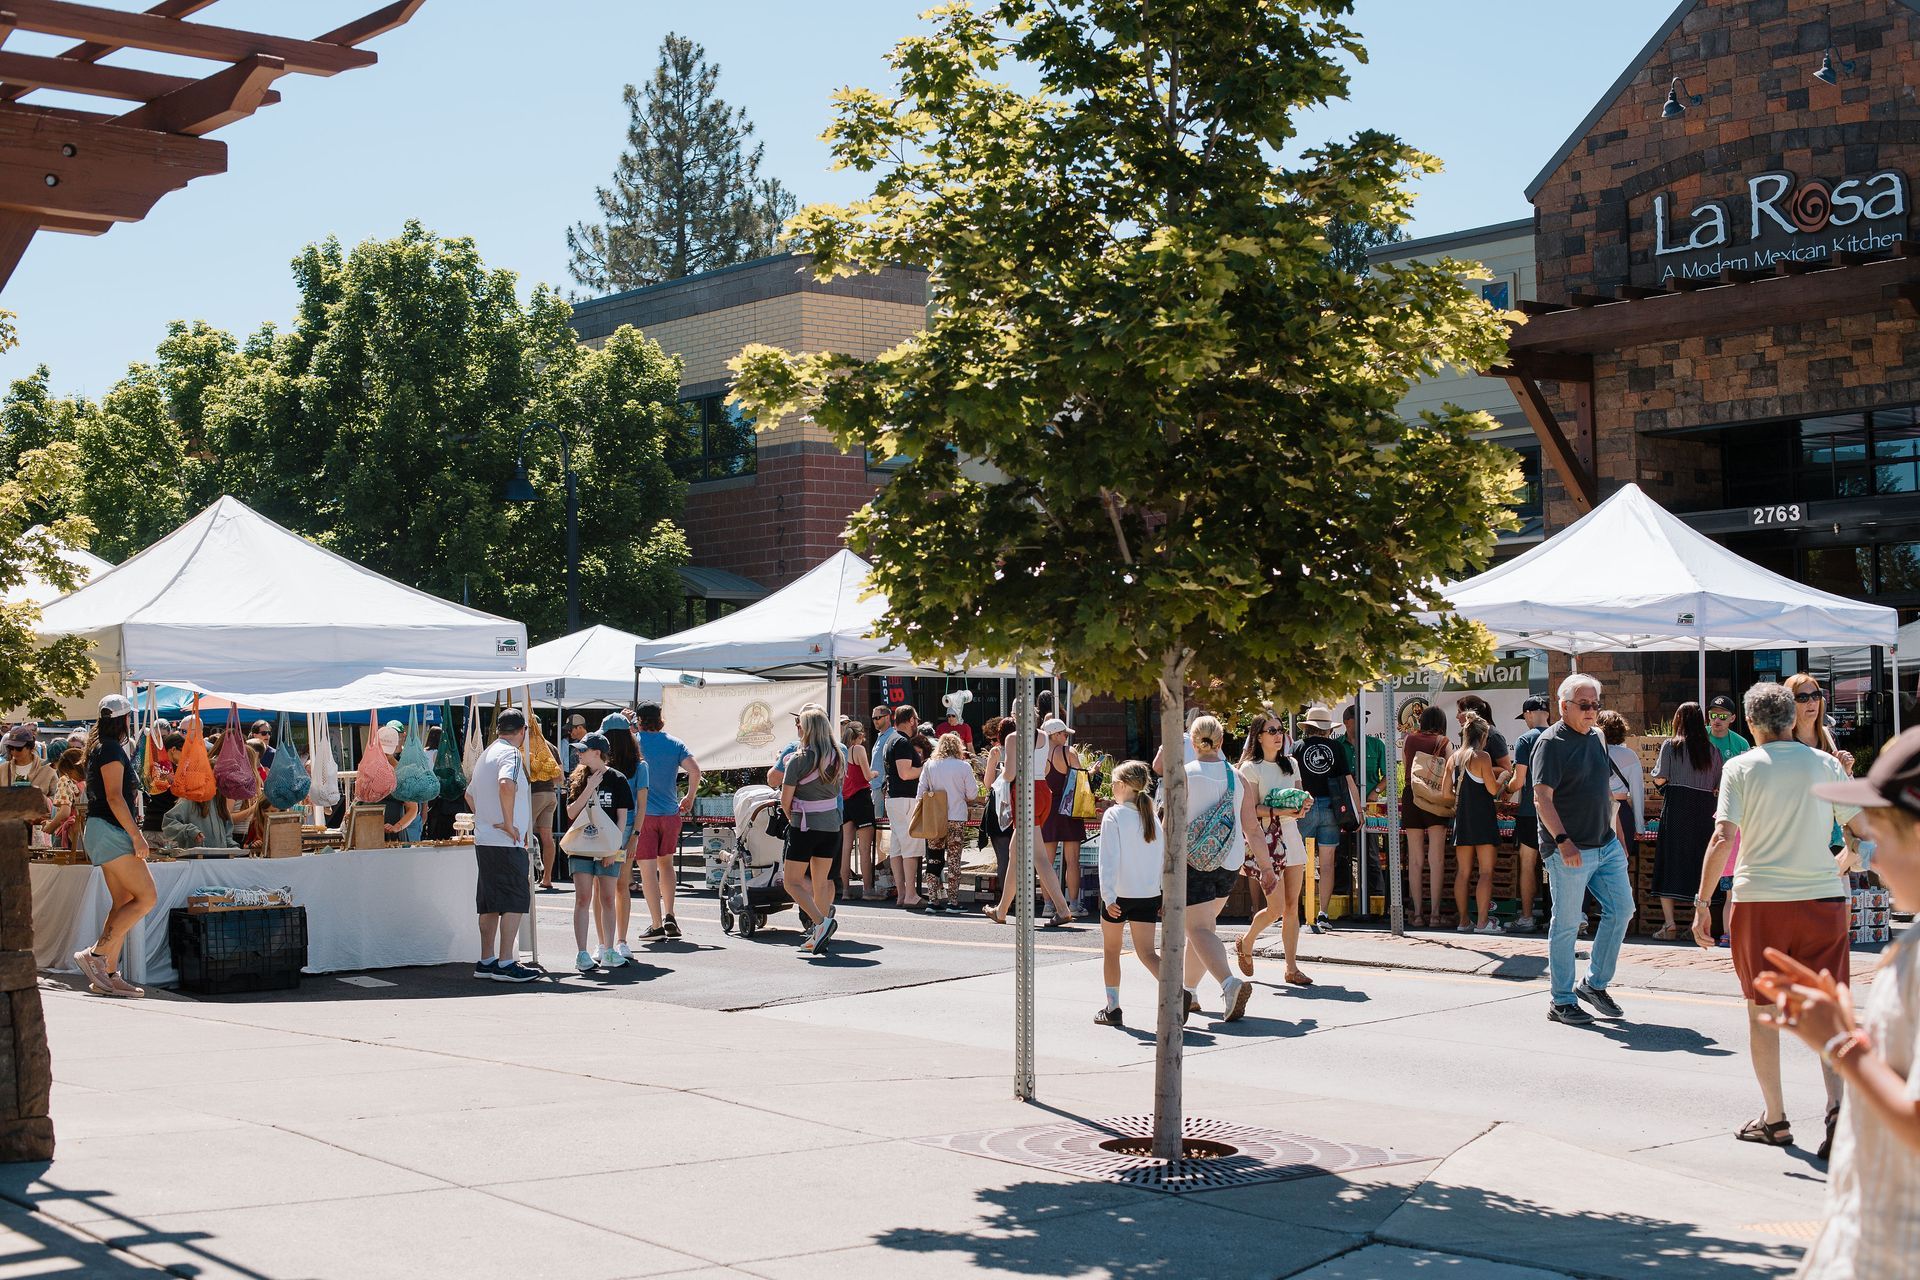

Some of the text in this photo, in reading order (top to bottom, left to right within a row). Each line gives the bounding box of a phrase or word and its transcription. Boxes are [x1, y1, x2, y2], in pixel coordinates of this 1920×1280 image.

[1654, 172, 1905, 256] La Rosa
[1661, 227, 1903, 283] A Modern Mexican Kitchen
[1753, 504, 1801, 525] 2763
[1474, 664, 1522, 684] Man
